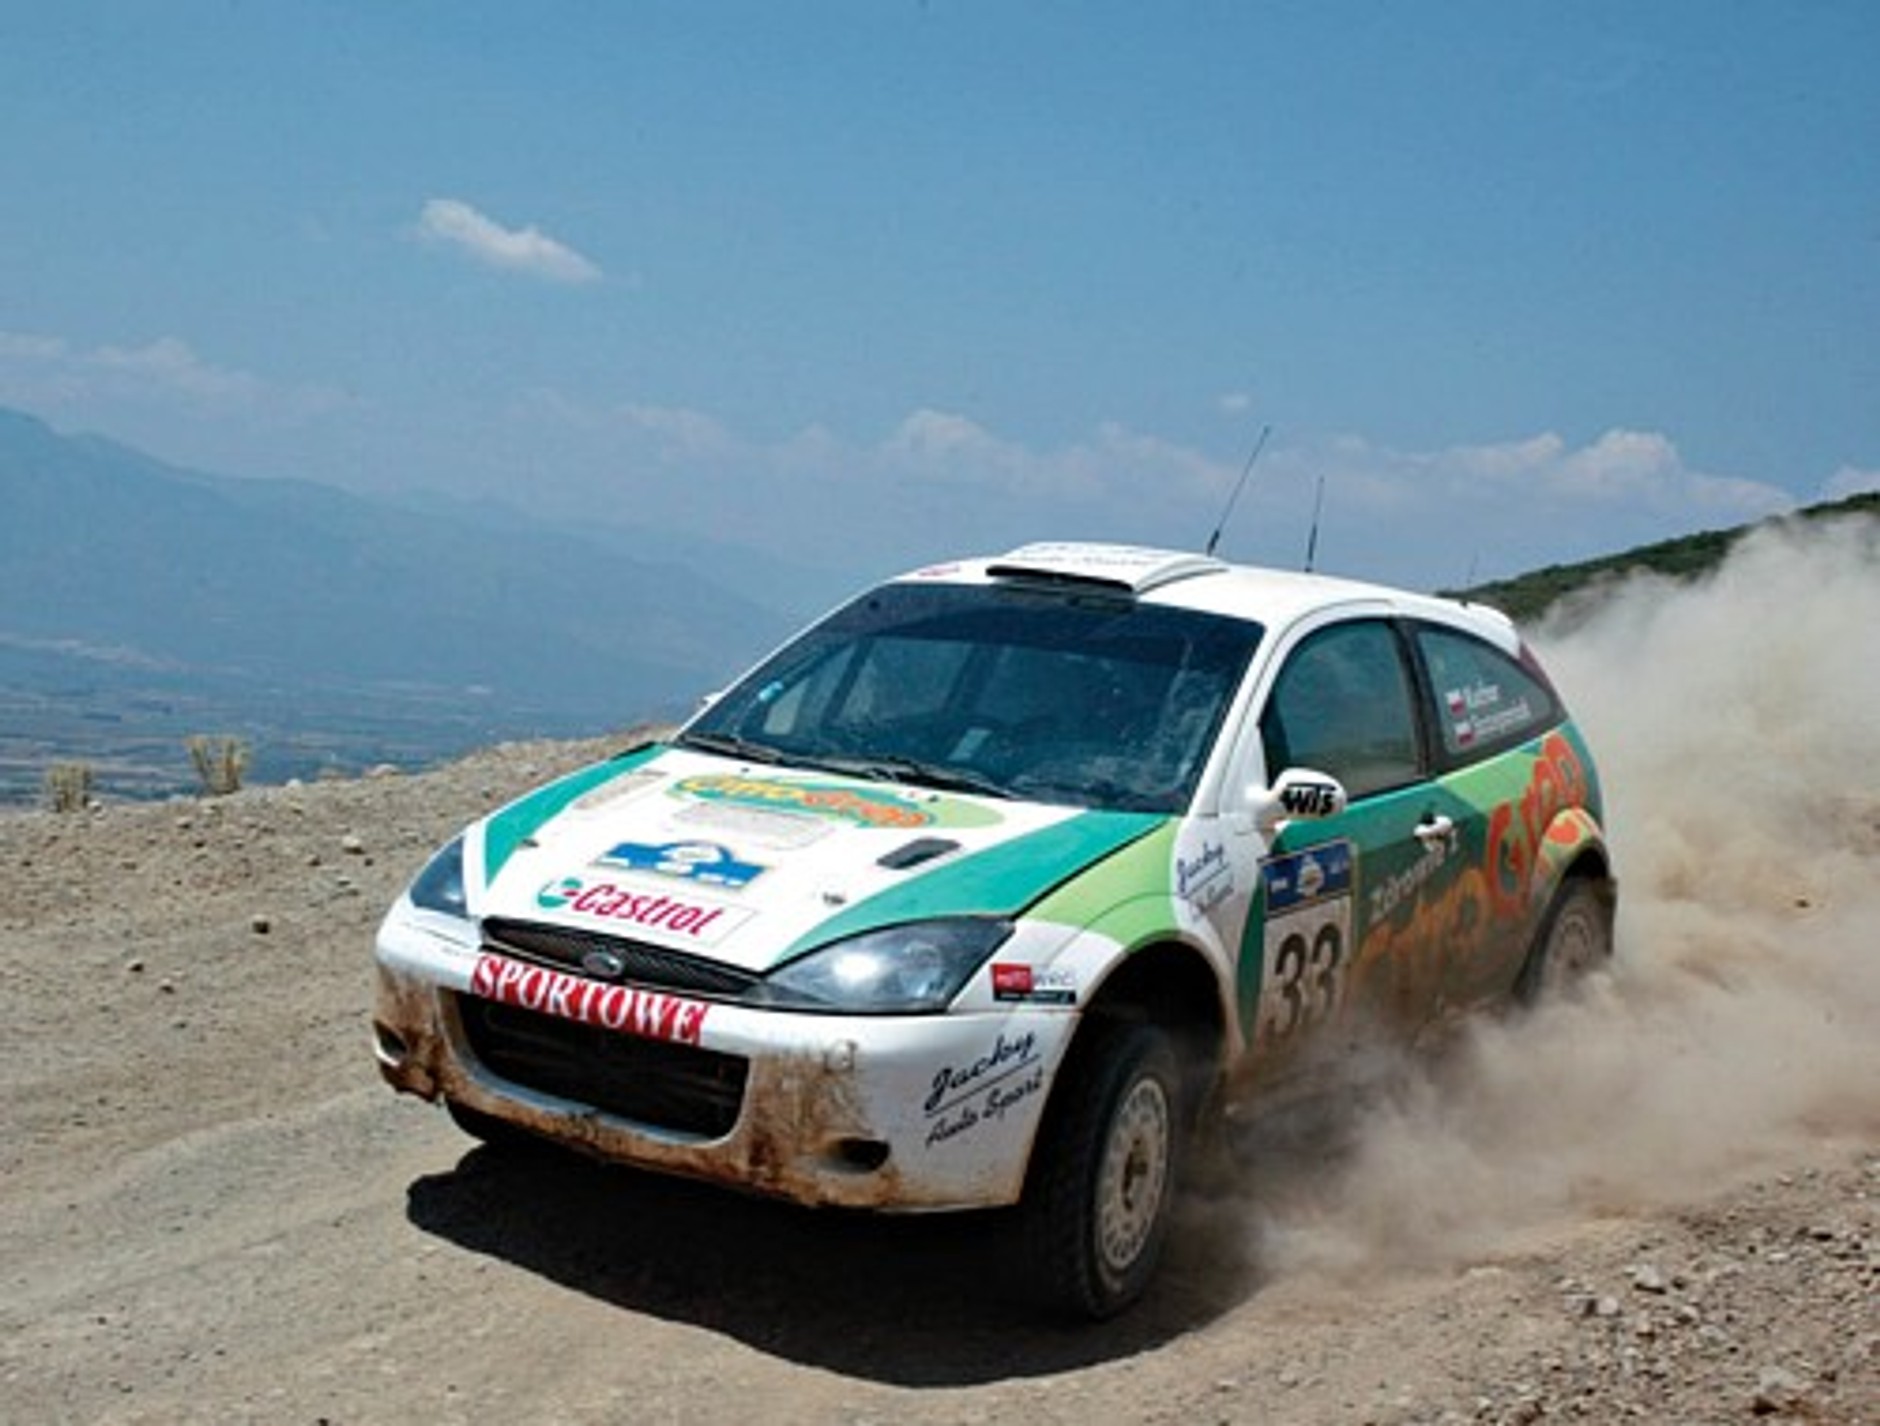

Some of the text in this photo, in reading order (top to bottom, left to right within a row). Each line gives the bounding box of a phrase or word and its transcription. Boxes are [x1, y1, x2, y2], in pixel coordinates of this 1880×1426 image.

[573, 884, 724, 934] Castrol
[474, 953, 705, 1044] SPORTOWE
[1264, 921, 1341, 1036] 33
[924, 1032, 1036, 1110] Jacky
